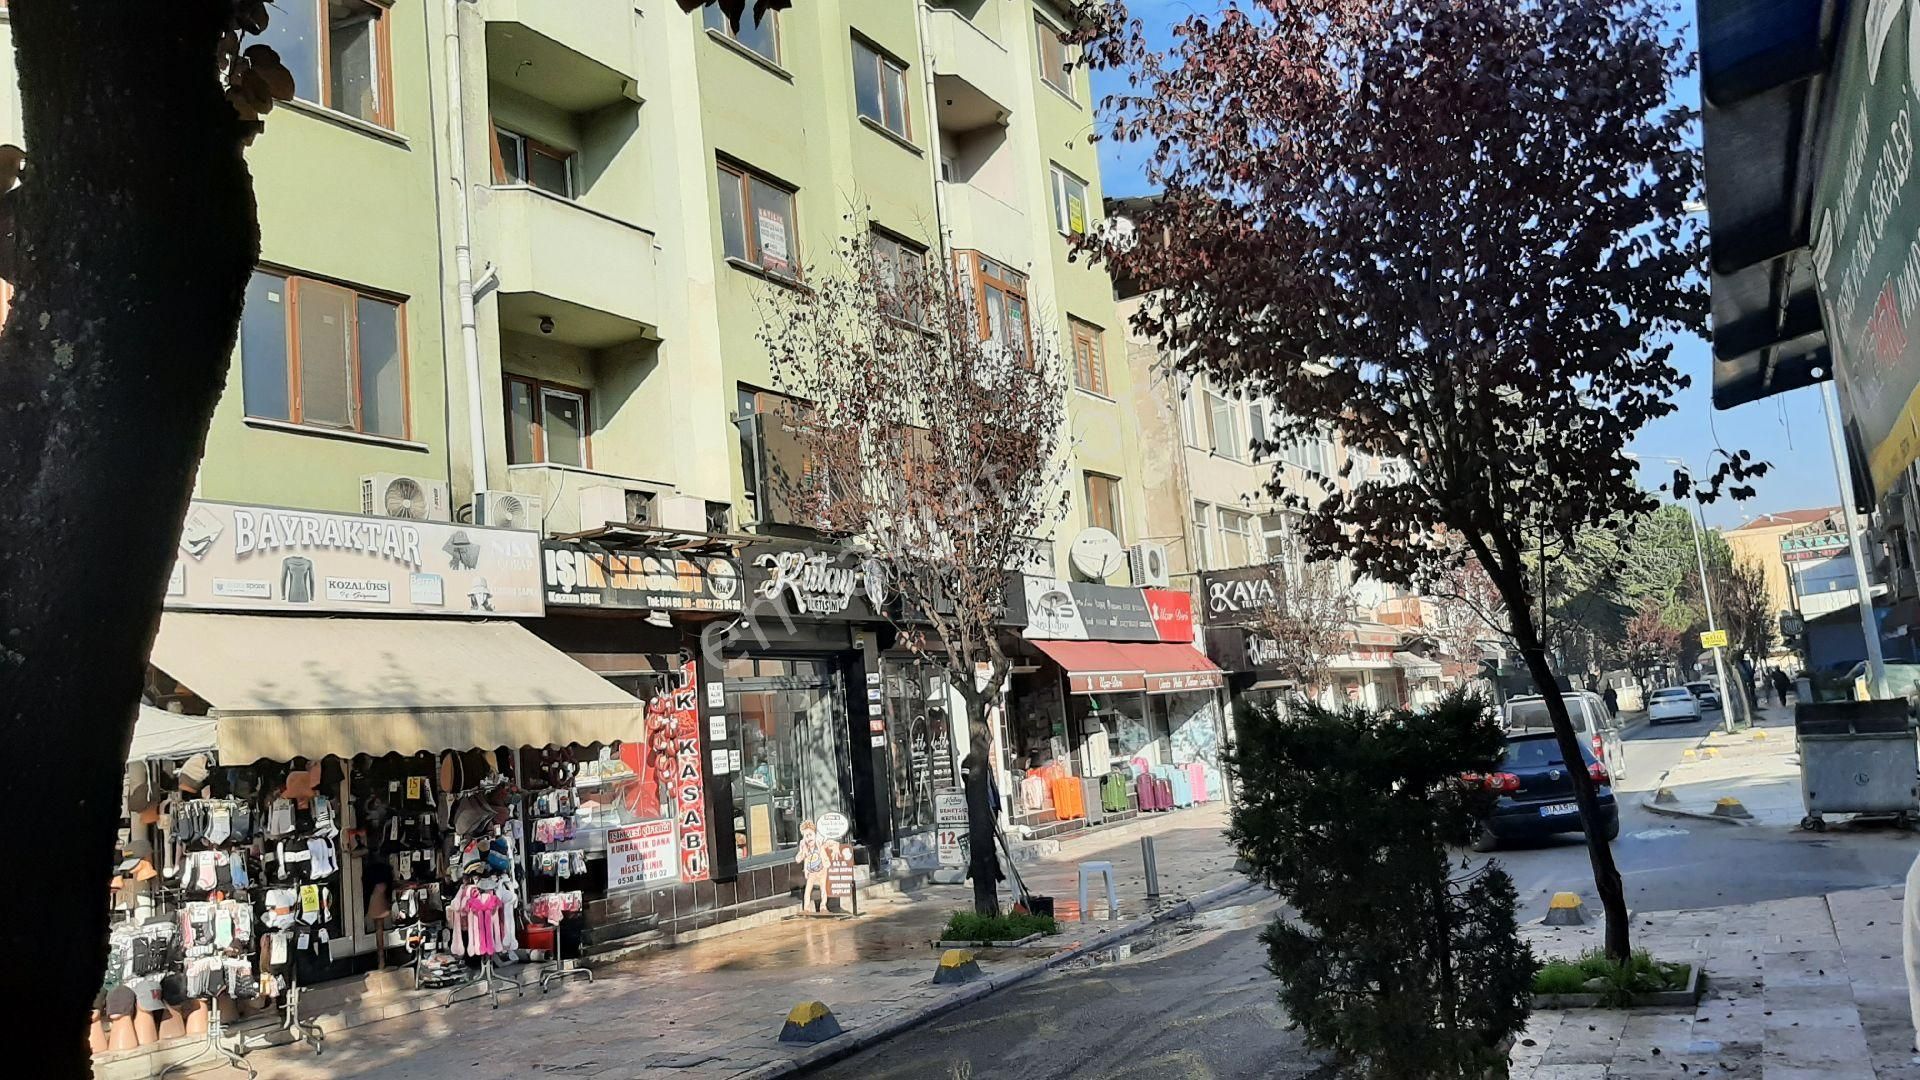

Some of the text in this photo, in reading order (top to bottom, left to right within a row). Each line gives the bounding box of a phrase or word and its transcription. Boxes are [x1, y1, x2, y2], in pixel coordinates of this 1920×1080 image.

[234, 510, 423, 567] BAYRAKTAR
[544, 549, 703, 594] IŞIK KASABI
[1210, 579, 1276, 613] KAYA
[611, 841, 649, 855] KURBANLIK
[939, 831, 957, 845] 12
